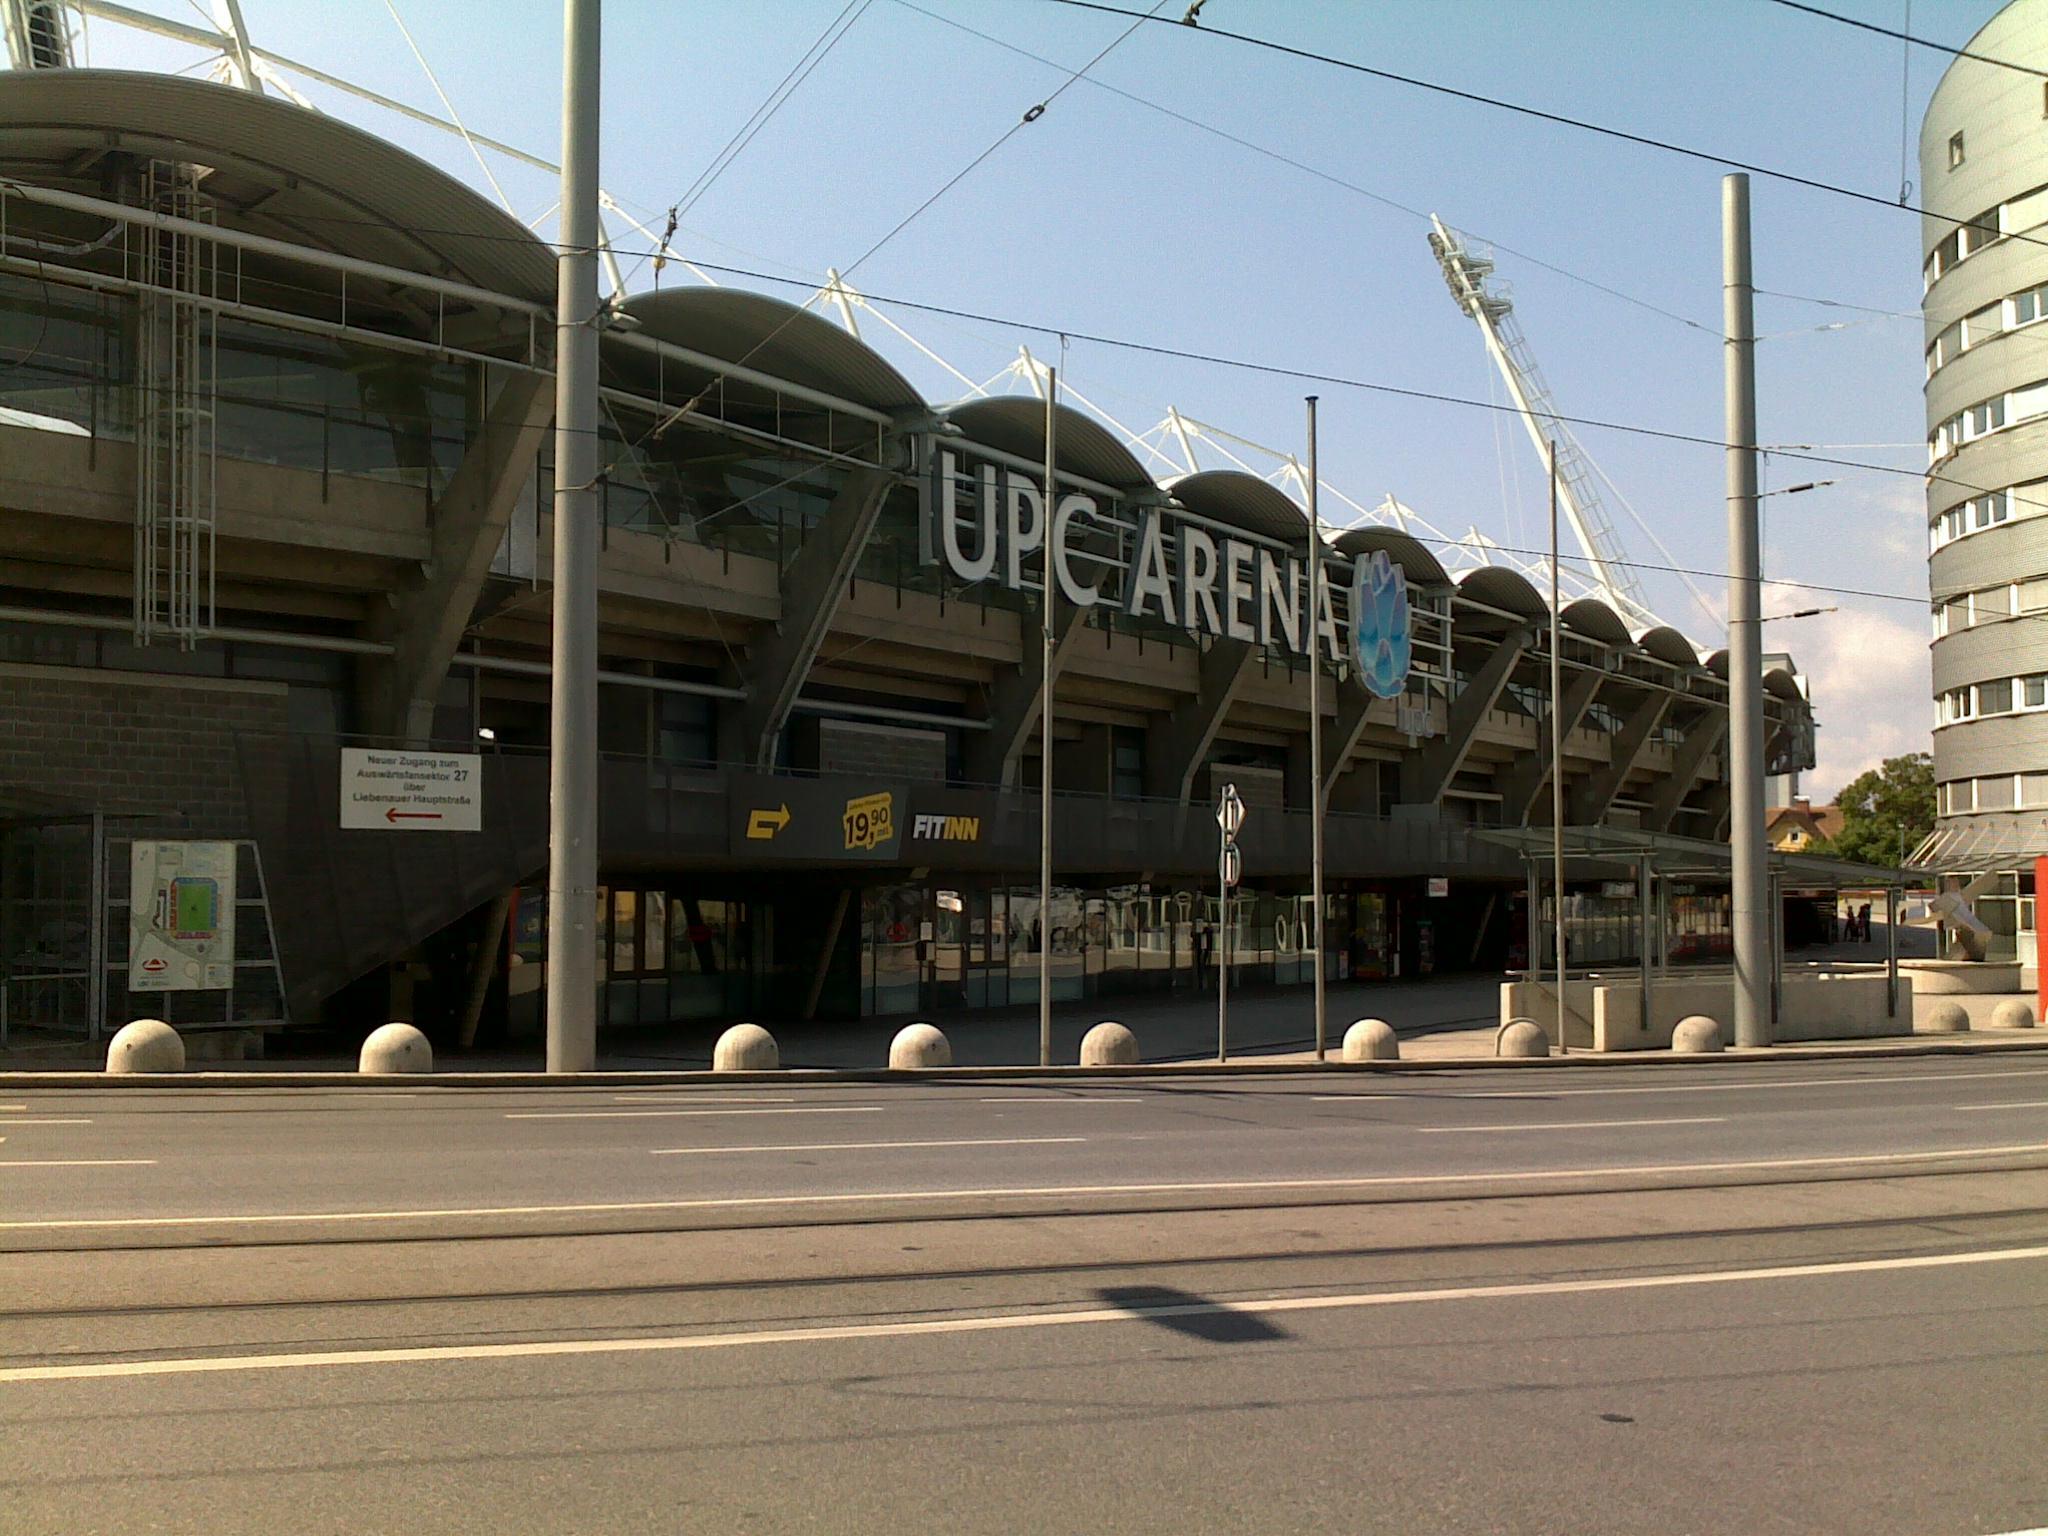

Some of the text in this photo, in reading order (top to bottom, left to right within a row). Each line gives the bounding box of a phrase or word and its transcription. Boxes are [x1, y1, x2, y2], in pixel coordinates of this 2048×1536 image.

[938, 450, 1341, 662] UPC ARENA
[367, 755, 460, 769] Neuer Zugang zum
[453, 770, 470, 782] 27
[403, 782, 426, 792] über
[352, 792, 471, 806] Liebenauer Hauptstraße
[912, 814, 980, 841] FITINN
